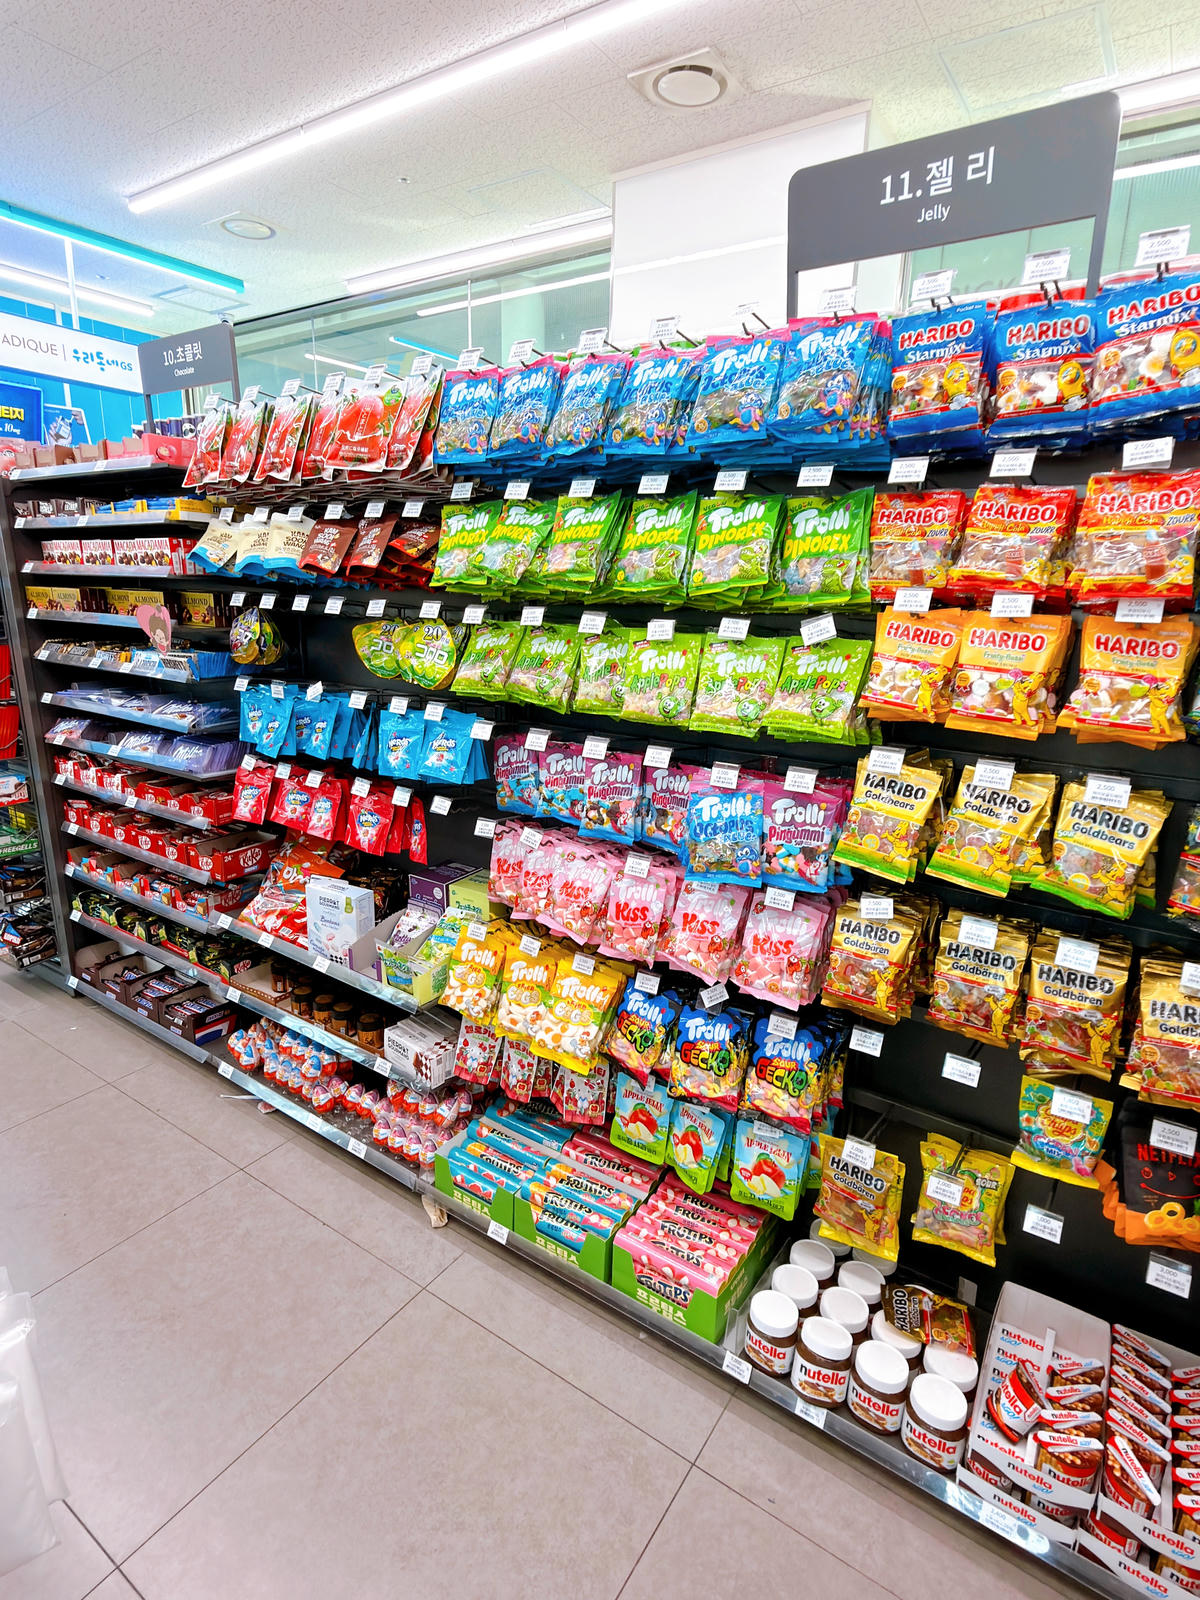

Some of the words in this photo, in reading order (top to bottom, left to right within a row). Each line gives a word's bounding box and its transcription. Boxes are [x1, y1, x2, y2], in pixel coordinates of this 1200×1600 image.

[880, 156, 954, 206] 11.젤
[966, 145, 995, 186] 리
[917, 201, 951, 224] Jelly
[1106, 284, 1200, 327] HARIBO
[899, 317, 976, 351] HARIBO
[1006, 314, 1091, 348] HARIBO
[1118, 306, 1195, 338] Starmix
[162, 340, 204, 367] 10.초콜릿
[799, 321, 864, 361] Trolli
[906, 340, 968, 363] Starmix
[1014, 340, 1080, 362] Starmix
[711, 339, 772, 375] Trolli
[173, 365, 196, 378] Chocolate
[503, 367, 550, 398] Trolli
[633, 355, 683, 387] Trolli
[449, 379, 494, 404] Trolli
[977, 501, 1058, 524] HARIBO
[1098, 487, 1195, 516] HARIBO
[447, 508, 492, 535] Trolli
[506, 506, 550, 526] Trolli
[564, 502, 612, 528] Trolli
[635, 502, 686, 536] Trolli
[707, 500, 768, 534] Trolli
[792, 502, 851, 538] Trolli
[878, 506, 949, 525] HARIBO
[440, 529, 488, 551] DINOREX
[490, 524, 537, 544] DINOREX
[553, 524, 604, 544] DINOREX
[623, 528, 683, 550] DINOREX
[698, 521, 766, 551] DINOREX
[784, 532, 852, 559] DINOREX
[56, 592, 78, 602] ALMOND
[134, 595, 159, 605] ALMOND
[184, 595, 209, 606] ALMOND
[475, 632, 514, 649] Trolli
[530, 638, 572, 655] Trolli
[886, 620, 956, 649] HARIBO
[970, 627, 1048, 652] HARIBO
[1095, 633, 1182, 660] HARIBO
[638, 649, 688, 673] Trolli
[714, 653, 769, 677] Trolli
[796, 653, 851, 675] Trolli
[497, 745, 528, 766] Trolli
[591, 762, 635, 784] Trolli
[652, 768, 693, 794] Trolli
[587, 784, 635, 800] Pingummi
[863, 771, 928, 801] HARIBO
[696, 793, 753, 822] Trolli
[771, 797, 828, 825] Trolli
[864, 789, 916, 812] Goldbears
[964, 783, 1032, 815] HARIBO
[1070, 801, 1150, 840] HARIBO
[768, 825, 827, 845] Pingummi
[1071, 821, 1136, 851] Goldbears
[0, 841, 39, 858] HEEGELLS
[839, 918, 901, 945] HARIBO
[461, 942, 498, 968] Trolli
[843, 936, 890, 956] Goldbären
[946, 941, 1016, 972] HARIBO
[510, 960, 549, 983] Trolli
[951, 961, 1005, 983] Goldbären
[1036, 962, 1116, 996] HARIBO
[560, 976, 611, 1006] Trolli
[1043, 984, 1104, 1007] Goldbären
[553, 1002, 594, 1024] EGGS
[628, 992, 666, 1021] Trolli
[1150, 1000, 1200, 1023] HAR
[617, 1010, 655, 1053] GECKO
[686, 1018, 733, 1041] Trolli
[696, 1040, 721, 1052] SOUR
[764, 1034, 813, 1061] Trolli
[680, 1042, 731, 1077] GECKO
[771, 1057, 797, 1070] SOUR
[756, 1057, 808, 1097] GECKO
[622, 1089, 644, 1103] APPLE
[644, 1095, 665, 1113] JELLY
[1041, 1117, 1078, 1138] Chups
[1161, 1127, 1181, 1138] 2,500
[829, 1156, 886, 1193] HARIBO
[975, 1176, 999, 1191] SOUR
[832, 1173, 876, 1202] Goldbären
[892, 1288, 908, 1333] HARIBO
[745, 1326, 787, 1360] nutella
[1001, 1328, 1045, 1352] nutella
[1124, 1331, 1150, 1352] nutella
[799, 1362, 847, 1386] nutella
[1122, 1351, 1150, 1373] nutella
[1056, 1387, 1081, 1395] nutella
[1121, 1373, 1150, 1397] nutella
[851, 1385, 900, 1418] nutella
[1120, 1395, 1149, 1420] nutella
[1051, 1411, 1079, 1420] nutella
[905, 1418, 957, 1456] nutella
[1048, 1434, 1079, 1445] nutella
[1118, 1418, 1149, 1444] nutella
[1007, 1461, 1053, 1491] nutella
[1121, 1447, 1145, 1481] nutella
[993, 1493, 1037, 1524] nutella
[1142, 1525, 1196, 1556] nutella
[1118, 1560, 1169, 1595] nutella
